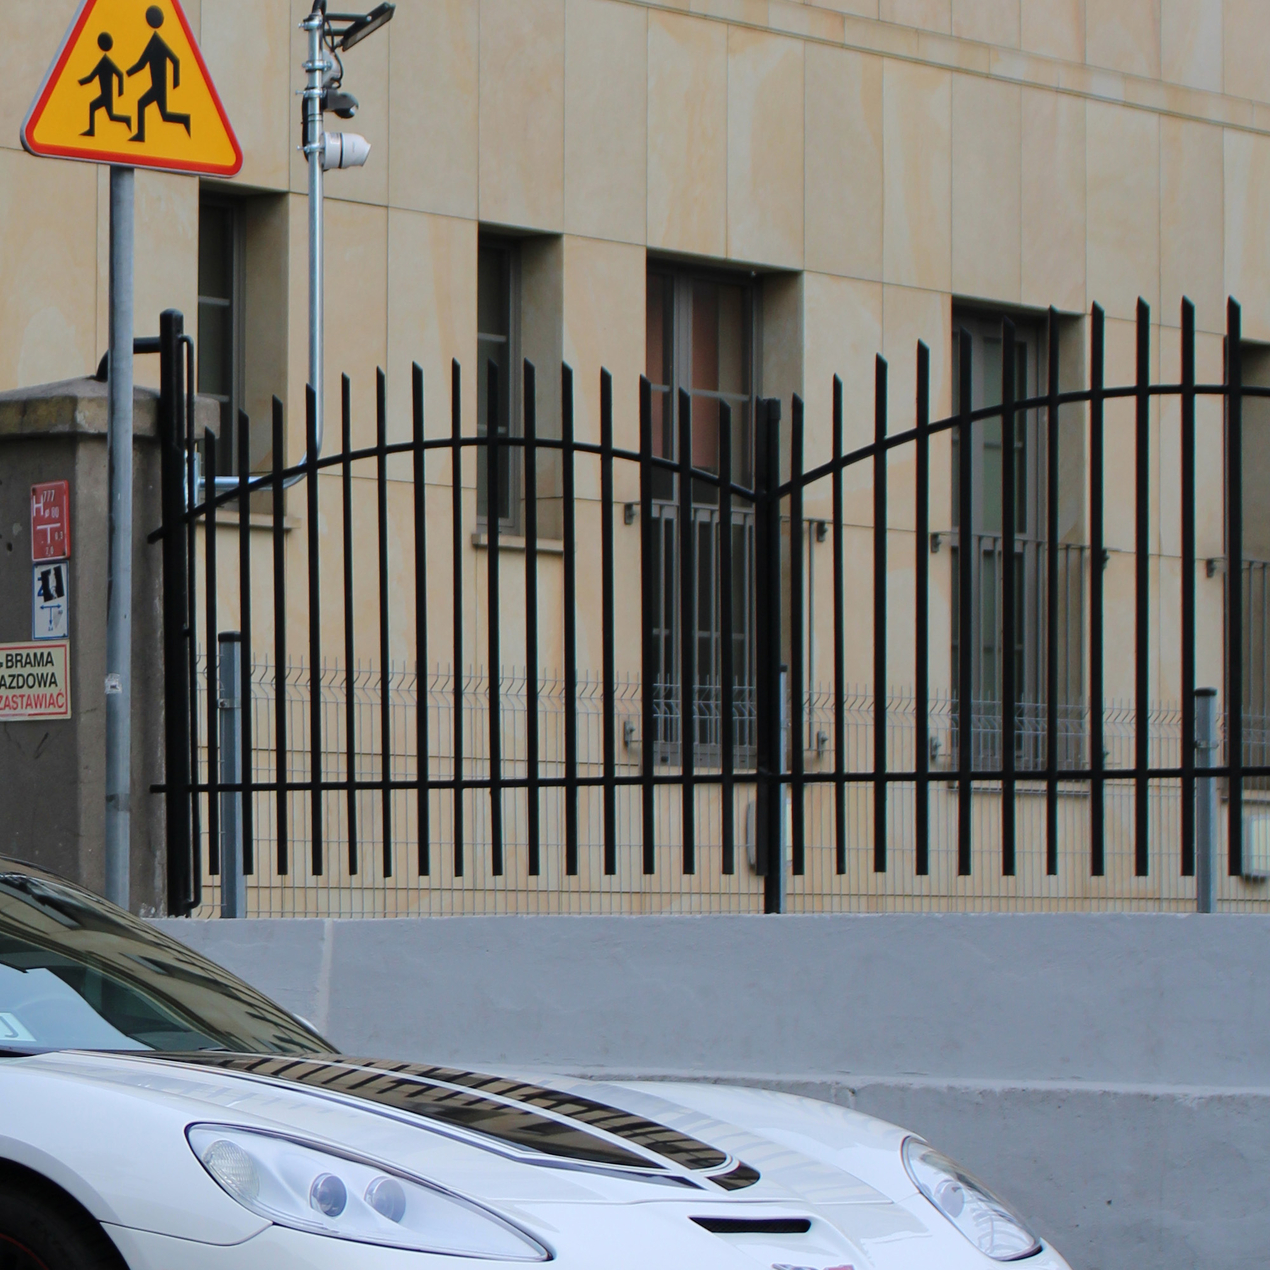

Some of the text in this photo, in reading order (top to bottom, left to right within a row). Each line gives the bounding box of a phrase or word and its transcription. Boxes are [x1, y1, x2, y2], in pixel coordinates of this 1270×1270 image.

[43, 489, 55, 502] 777
[33, 494, 44, 516] H
[5, 651, 54, 669] BRAMA
